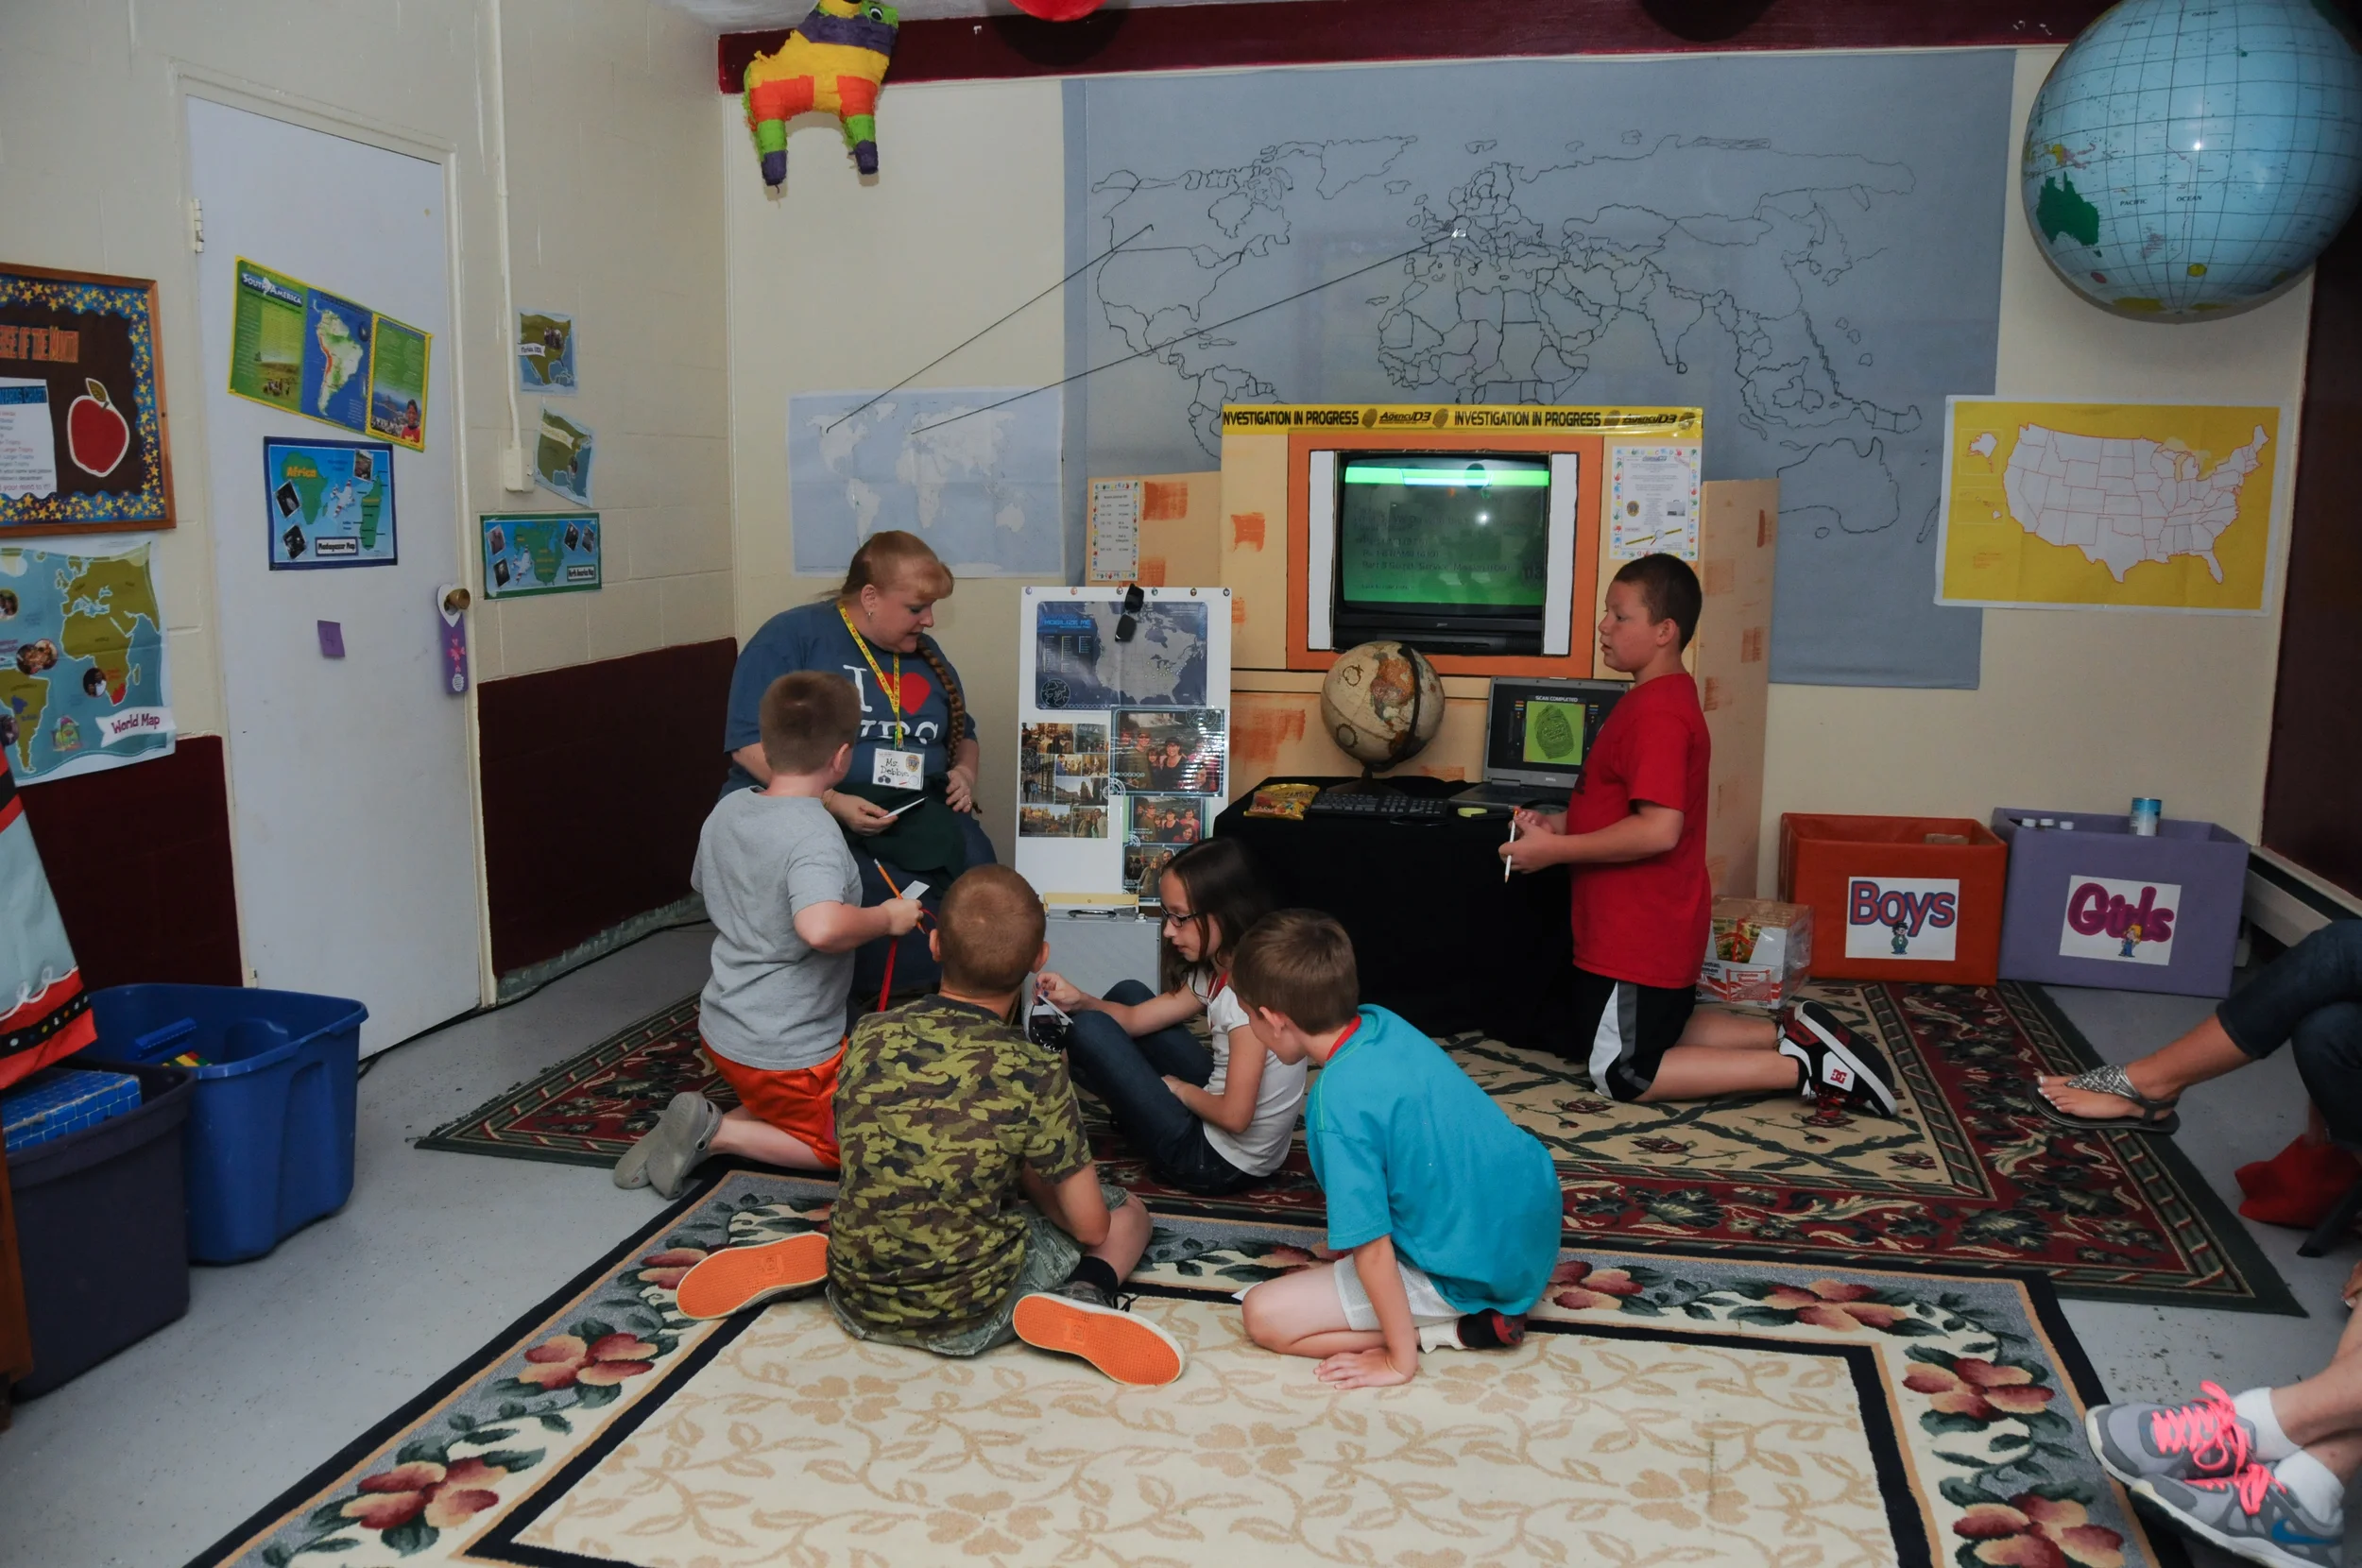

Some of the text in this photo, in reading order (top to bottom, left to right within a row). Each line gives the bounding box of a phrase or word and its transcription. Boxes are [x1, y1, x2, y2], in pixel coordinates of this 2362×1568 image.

[270, 284, 302, 304] AMERICA
[1223, 411, 1359, 425] NVESTIGATION IN PROGRESS
[1455, 412, 1601, 427] INVESTIGATION IN PROGRESS
[286, 466, 317, 478] Africa
[346, 542, 355, 551] Map
[843, 664, 872, 712] I
[111, 712, 161, 734] World Map
[881, 765, 910, 777] Debbie
[1849, 880, 1956, 936] Boys
[2066, 882, 2175, 942] Girls
